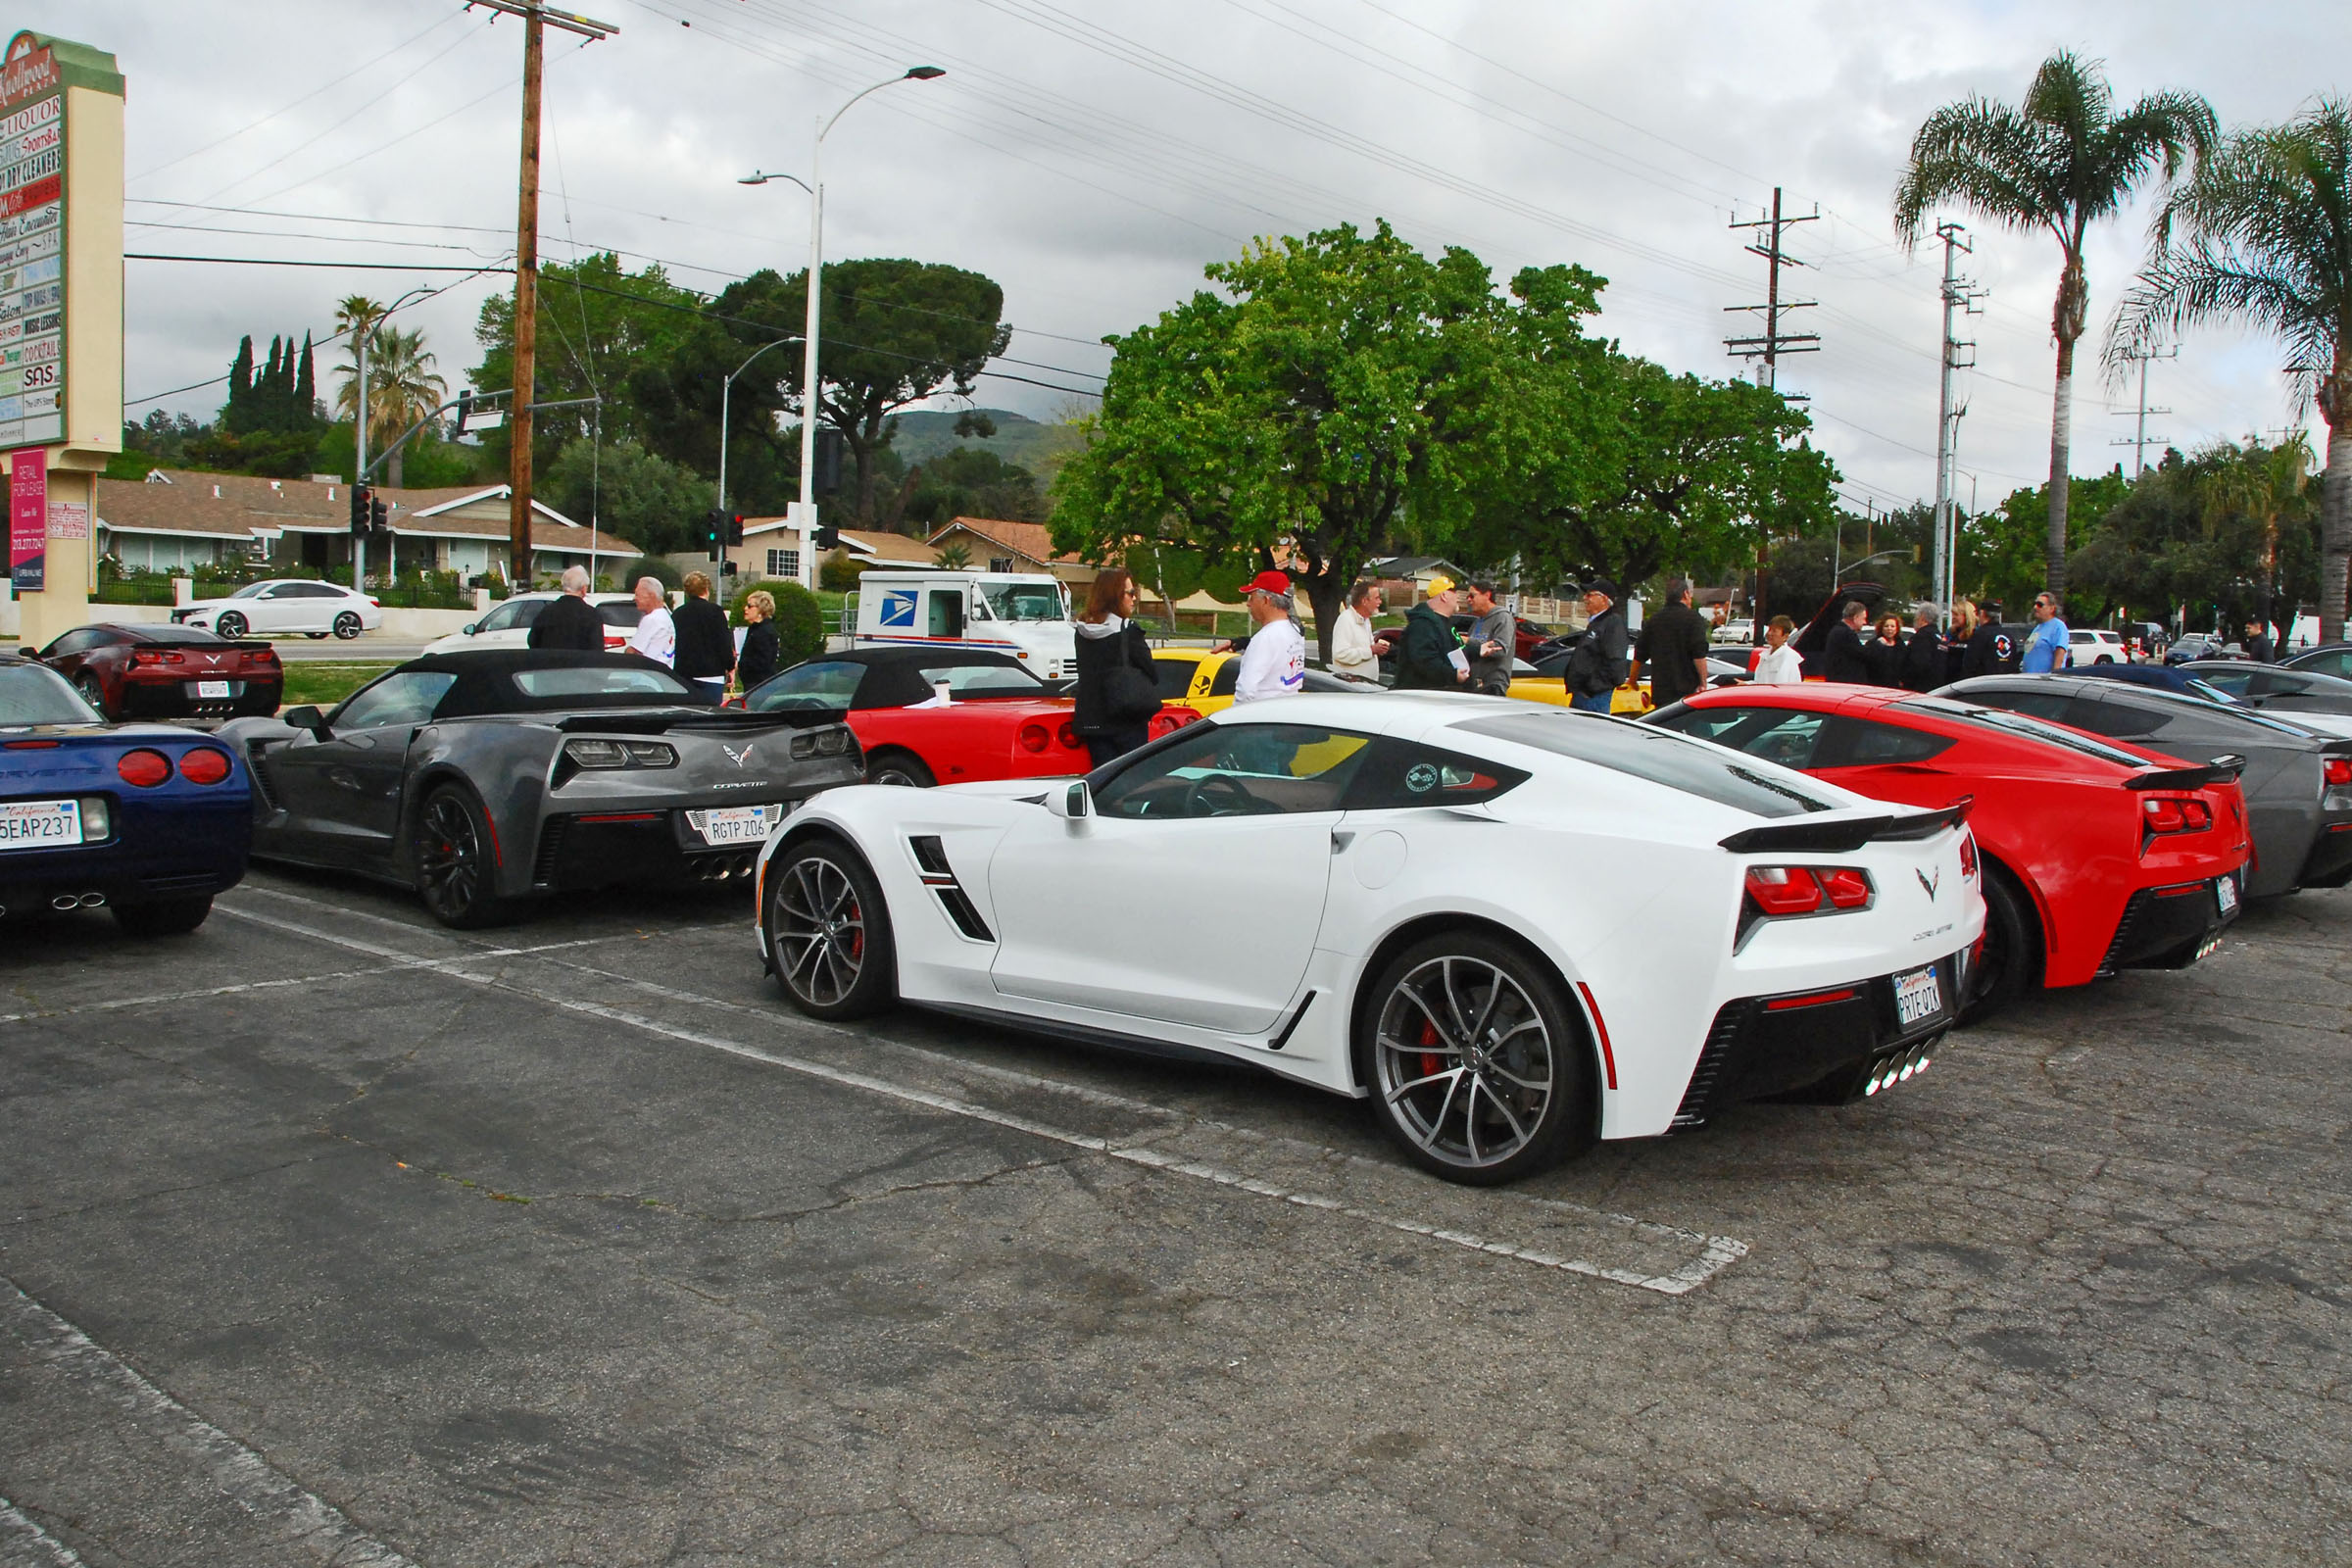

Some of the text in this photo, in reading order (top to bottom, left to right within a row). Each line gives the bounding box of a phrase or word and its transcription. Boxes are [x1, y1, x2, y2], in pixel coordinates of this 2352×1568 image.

[8, 96, 61, 135] LIQUOR
[7, 166, 20, 188] DRY
[23, 149, 61, 182] CLEANERS
[41, 312, 61, 331] LESSONS
[24, 340, 61, 362] COCKTAILS
[24, 365, 53, 386] SAS
[712, 781, 768, 790] CORVETTE
[9, 806, 57, 818] California
[0, 815, 73, 839] 5EAP237
[712, 821, 740, 839] RGTP
[1898, 990, 1922, 1023] PRTE
